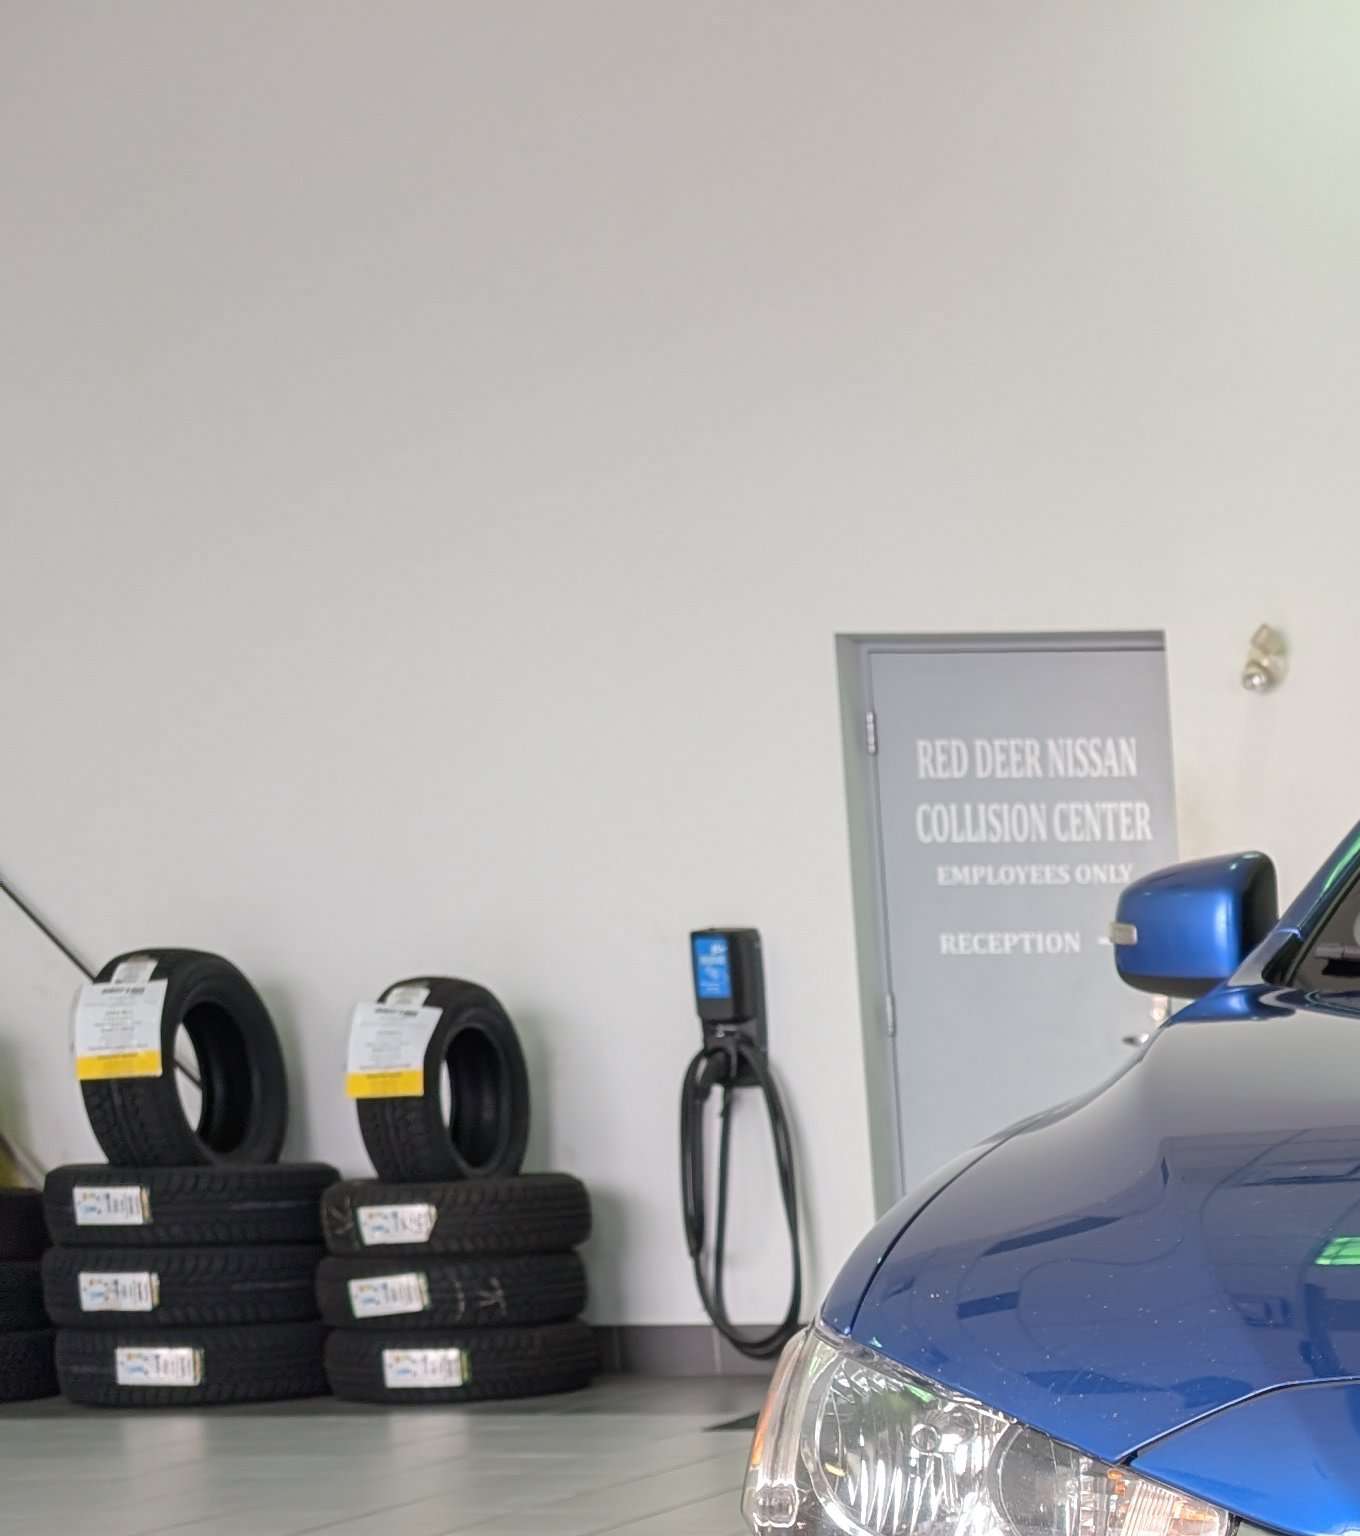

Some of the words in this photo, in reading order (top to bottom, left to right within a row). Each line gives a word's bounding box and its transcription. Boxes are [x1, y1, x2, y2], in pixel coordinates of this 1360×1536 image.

[917, 740, 968, 779] RED
[974, 739, 1043, 779] DEER
[1048, 737, 1137, 777] NISSAN
[915, 803, 1047, 843] COLLISION
[1053, 802, 1152, 842] CENTER
[937, 864, 1070, 886] EMPLOYEES
[1075, 863, 1133, 884] ONLY
[940, 932, 1080, 955] RECEPTION
